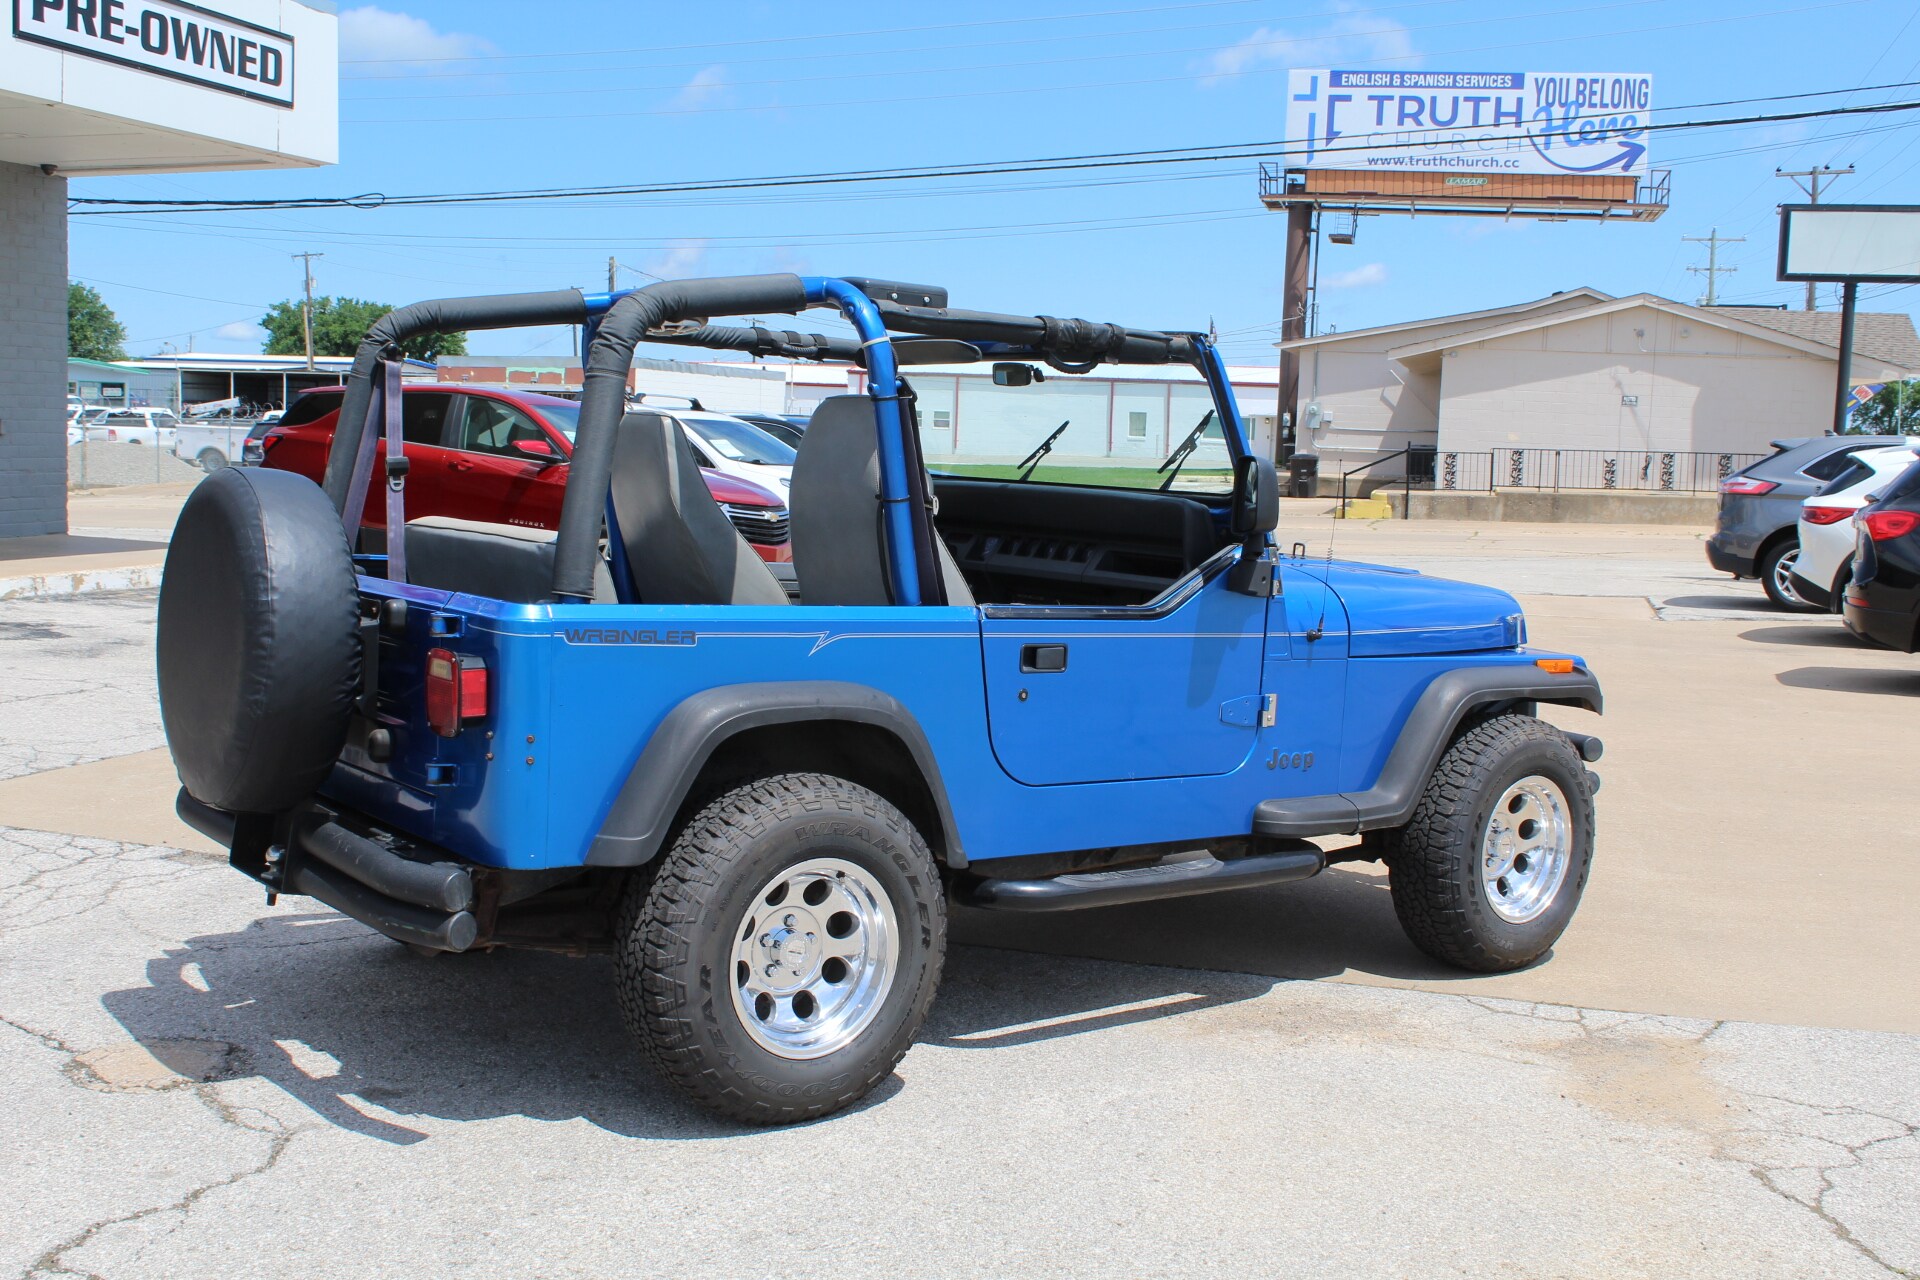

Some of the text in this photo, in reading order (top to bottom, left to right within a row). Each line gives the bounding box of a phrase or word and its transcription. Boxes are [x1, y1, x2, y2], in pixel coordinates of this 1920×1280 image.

[1341, 73, 1512, 88] ENGLISH & SPANISH SERVICES
[1534, 77, 1649, 110] YOU BELONG
[1367, 94, 1524, 128] TRUTH
[1532, 100, 1645, 151] Here
[1367, 131, 1522, 152] CHURCH
[1367, 155, 1520, 169] www.truthchurch.cc
[1448, 177, 1484, 185] LAMAR
[564, 628, 697, 644] WRANGLER
[1266, 747, 1315, 772] Jeep
[795, 821, 932, 950] WRANGLER
